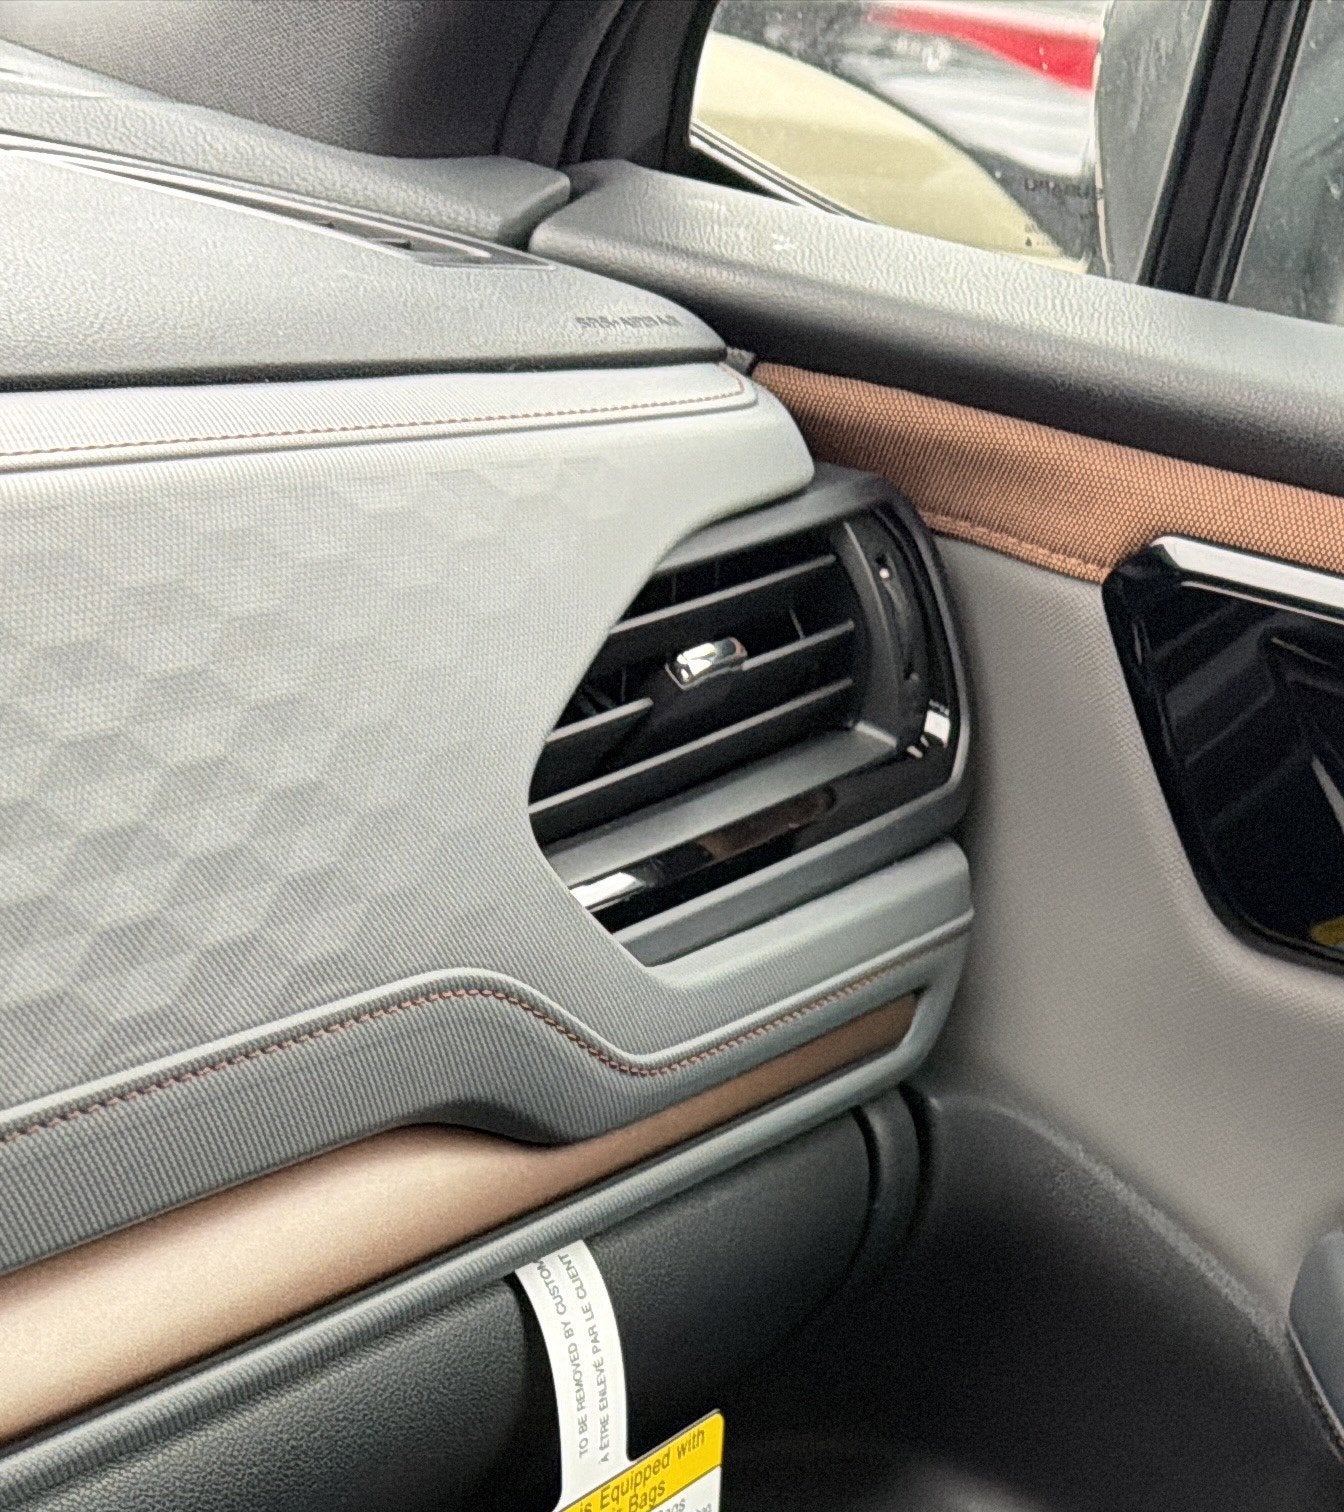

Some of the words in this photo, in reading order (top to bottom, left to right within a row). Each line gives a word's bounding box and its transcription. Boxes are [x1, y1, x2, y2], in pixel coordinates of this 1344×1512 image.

[557, 1253, 587, 1300] CLIENT
[581, 1302, 595, 1322] LE
[560, 1320, 575, 1340] BY
[588, 1324, 601, 1355] PAR
[567, 1342, 587, 1412] REMOVED
[577, 1414, 589, 1436] BE
[578, 1437, 589, 1459] TO
[599, 1446, 671, 1511] Equipped
[676, 1428, 705, 1460] with
